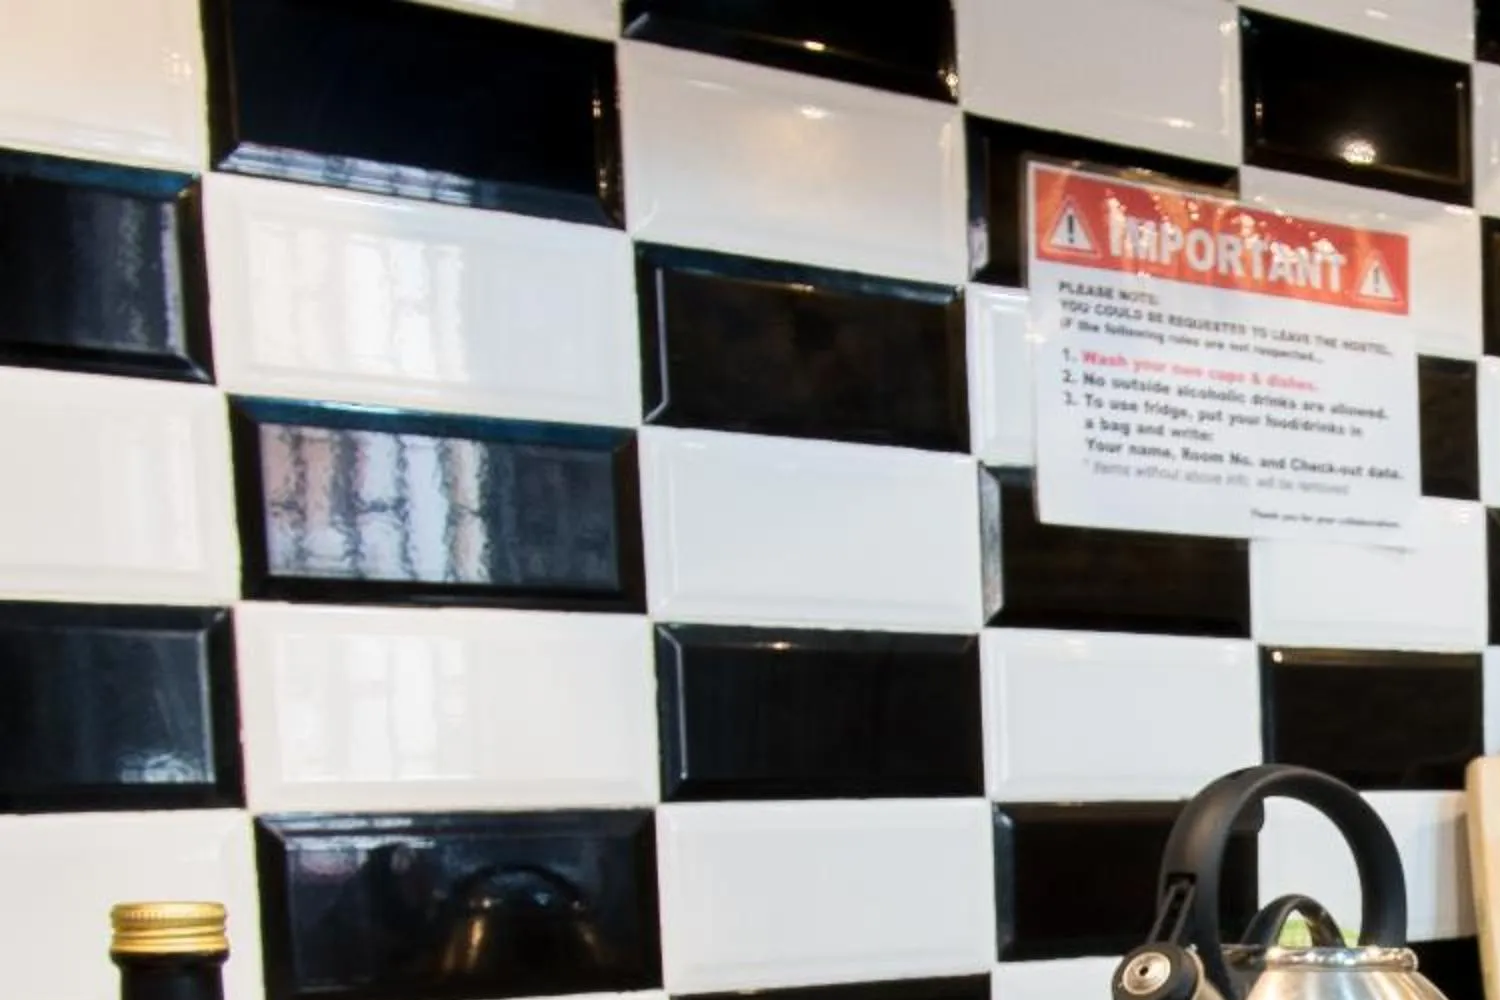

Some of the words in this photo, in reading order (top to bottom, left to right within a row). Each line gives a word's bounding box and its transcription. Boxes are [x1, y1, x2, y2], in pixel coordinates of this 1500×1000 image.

[1107, 212, 1347, 292] IMPORTANT
[1059, 281, 1113, 299] PLEASE
[1060, 300, 1089, 313] YOU
[1094, 303, 1142, 320] COULD
[1148, 311, 1163, 323] BE
[1168, 314, 1246, 335] REQUESTED
[1252, 326, 1267, 338] TO
[1272, 329, 1310, 345] LEAVE
[1314, 335, 1337, 348] THE
[1077, 319, 1099, 332] the
[1104, 322, 1164, 344] following
[1168, 334, 1199, 347] rules
[1205, 340, 1224, 350] are
[1229, 341, 1249, 352] not
[1062, 348, 1078, 362] 1.
[1081, 350, 1127, 366] Wash
[1132, 359, 1167, 374] your
[1171, 364, 1202, 376] own
[1208, 368, 1245, 386] cups
[1062, 369, 1078, 384] 2.
[1083, 371, 1106, 387] No
[1111, 376, 1170, 395] outside
[1176, 385, 1246, 404] alcoholic
[1252, 392, 1297, 410] drinks
[1303, 401, 1325, 413] are
[1330, 403, 1388, 420] allowed.
[1084, 393, 1104, 408] To
[1109, 401, 1138, 413] use
[1144, 400, 1192, 420] fridge,
[1198, 409, 1223, 424] put
[1229, 413, 1260, 428] your
[1350, 425, 1363, 437] in
[1084, 418, 1094, 430] a
[1100, 417, 1131, 436] bag
[1136, 423, 1165, 436] and
[1085, 437, 1123, 453] Your
[1129, 444, 1176, 460] name,
[1181, 447, 1224, 463] Room
[1229, 451, 1254, 467] No.
[1260, 456, 1286, 470] and
[1290, 457, 1363, 478] Check-out
[1367, 465, 1405, 480] date.
